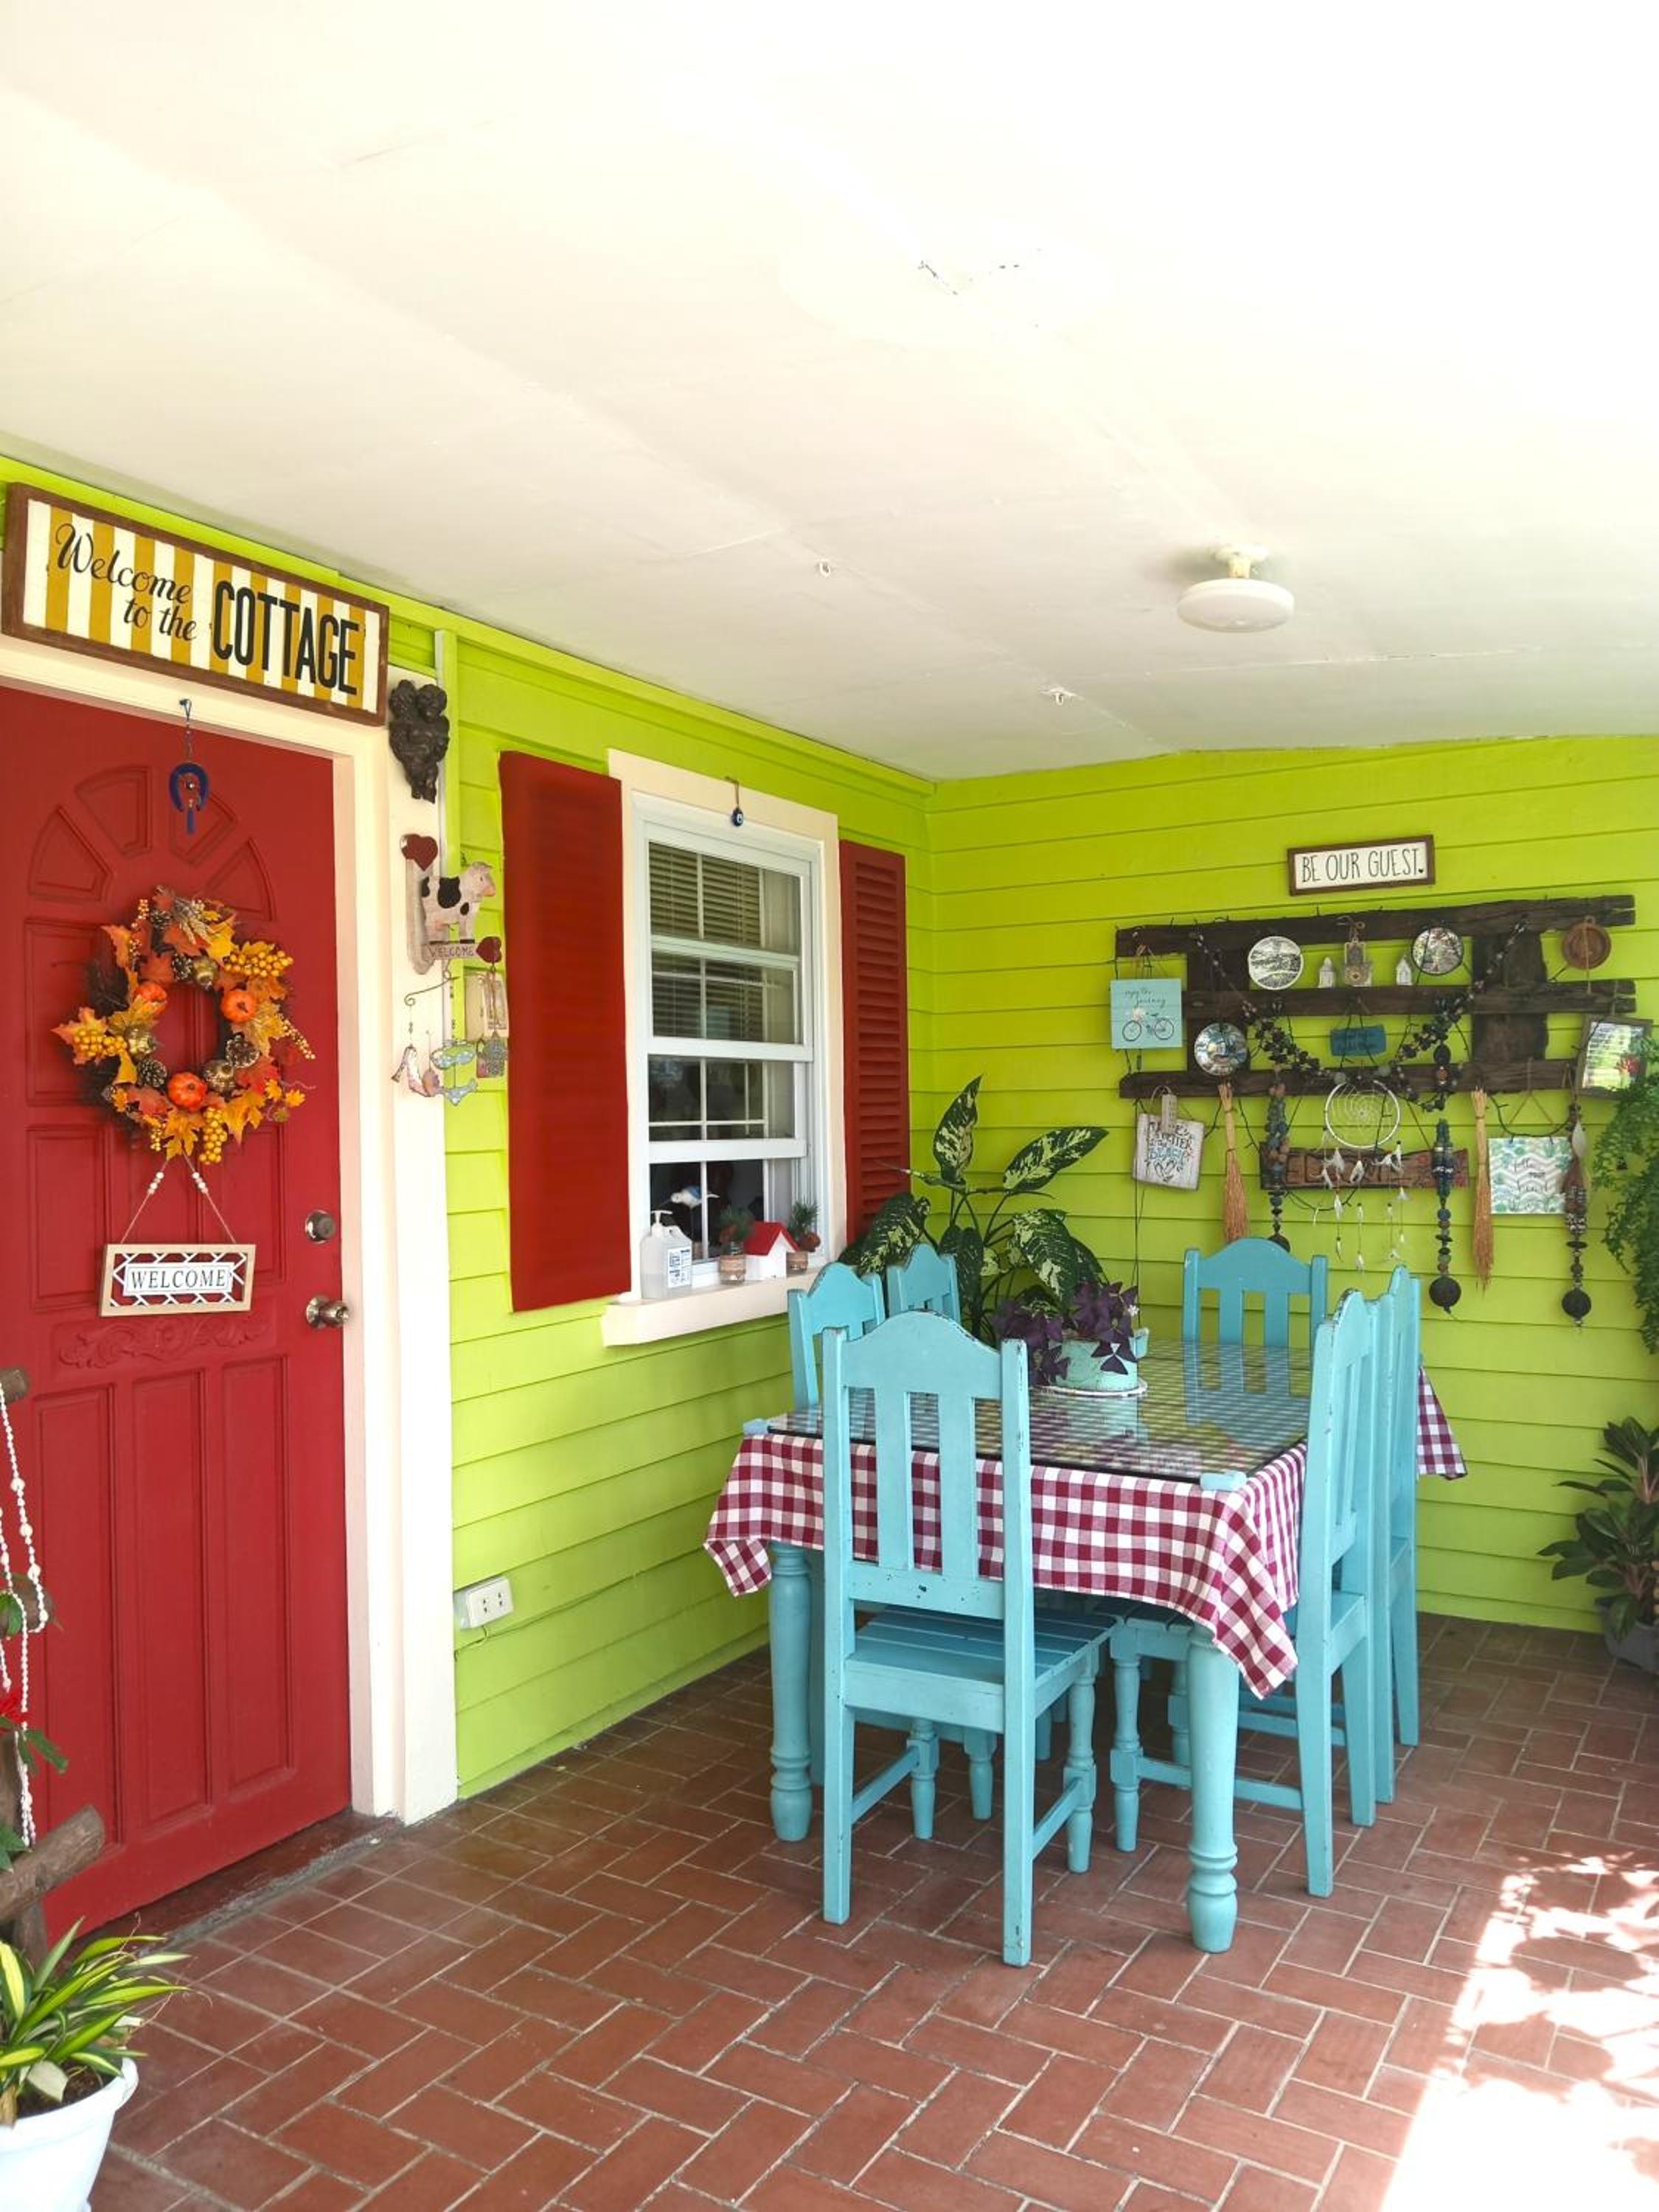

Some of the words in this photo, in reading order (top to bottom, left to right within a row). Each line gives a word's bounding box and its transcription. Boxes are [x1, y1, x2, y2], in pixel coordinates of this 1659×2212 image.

[55, 523, 191, 604] Welcome
[123, 598, 152, 628] to
[159, 605, 198, 641] the
[212, 580, 359, 695] COTTAGE
[1302, 855, 1320, 883] BE
[1326, 852, 1360, 880] OUR
[428, 945, 474, 958] WELCOME
[131, 1269, 226, 1289] WELCOME
